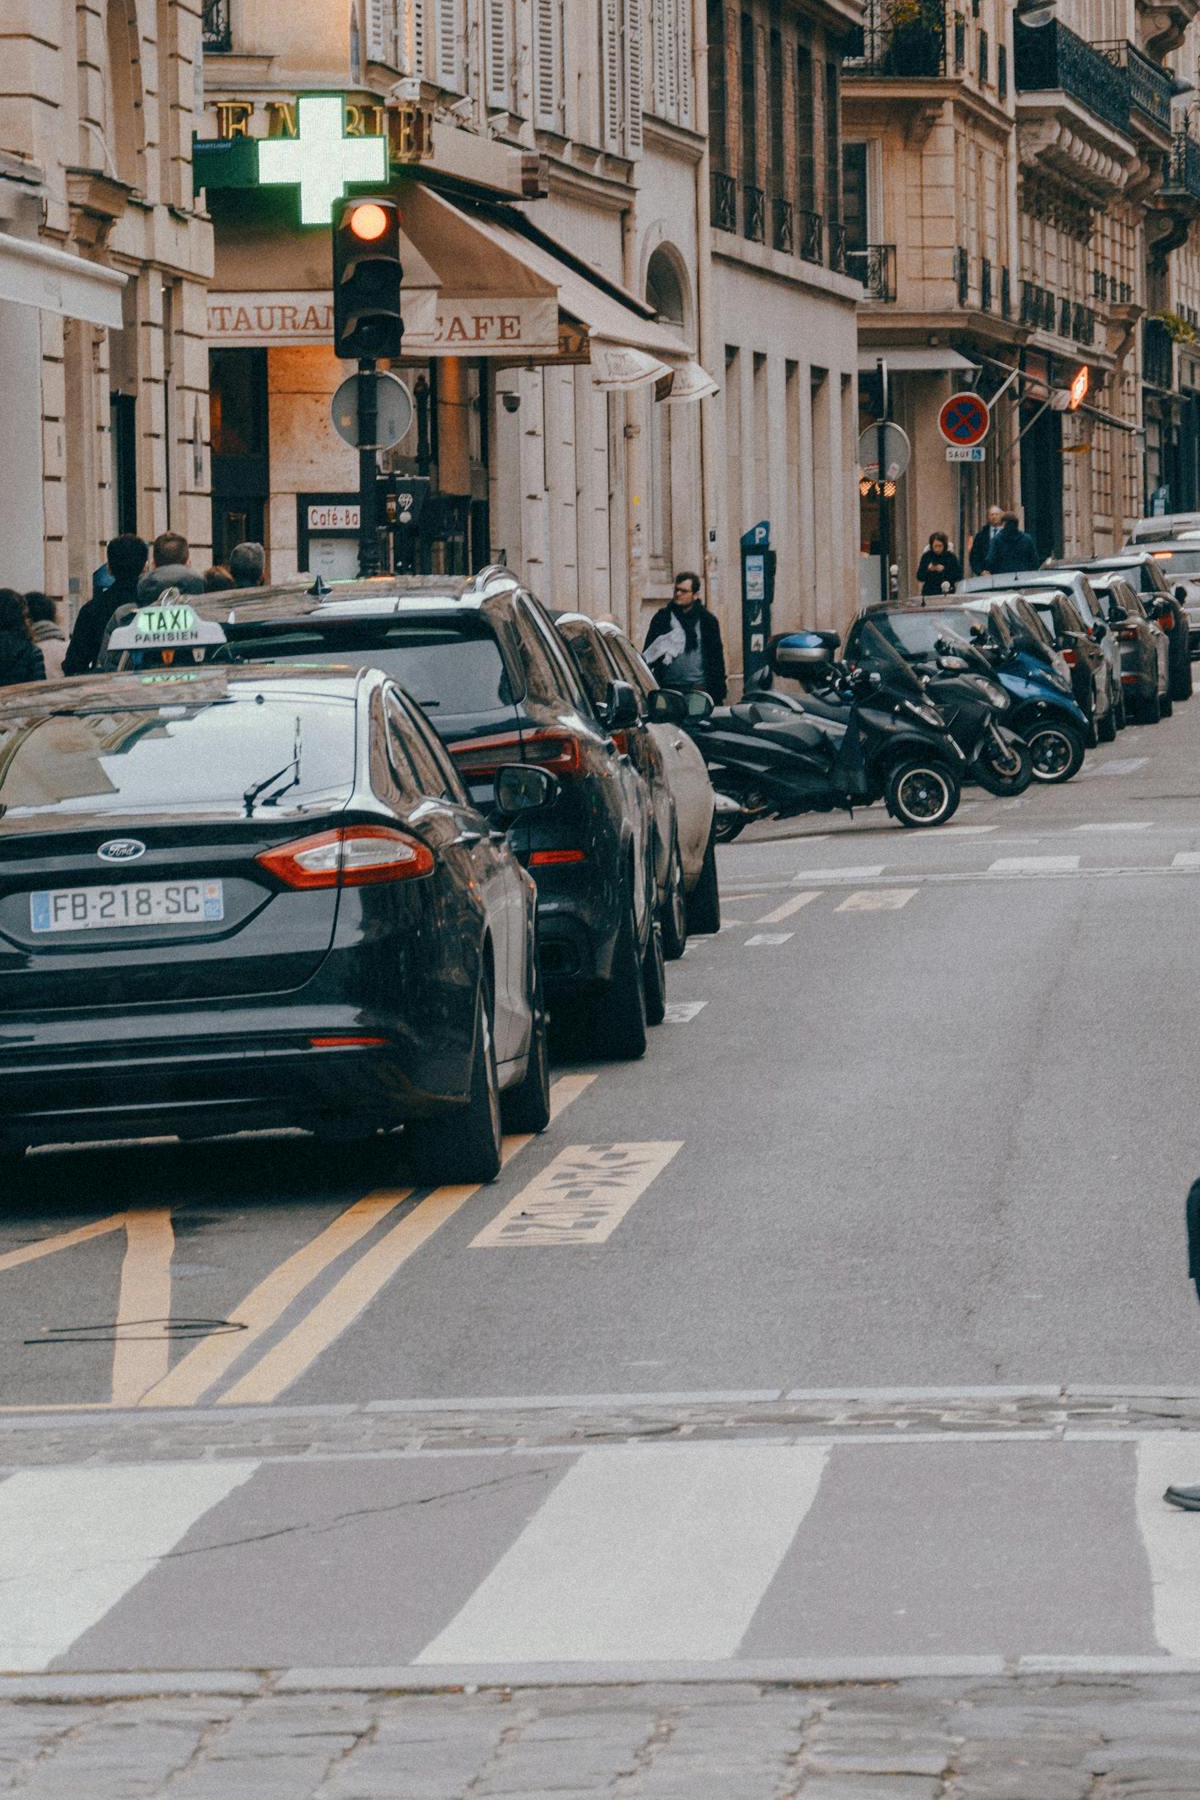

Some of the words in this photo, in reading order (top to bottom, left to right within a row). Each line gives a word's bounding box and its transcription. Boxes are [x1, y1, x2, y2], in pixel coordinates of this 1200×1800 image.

[206, 305, 333, 332] TAURA
[755, 527, 767, 544] P
[144, 610, 188, 631] TAXI
[135, 632, 198, 642] PARISIEN
[108, 843, 136, 857] Ford
[53, 886, 200, 922] FB-218-SC
